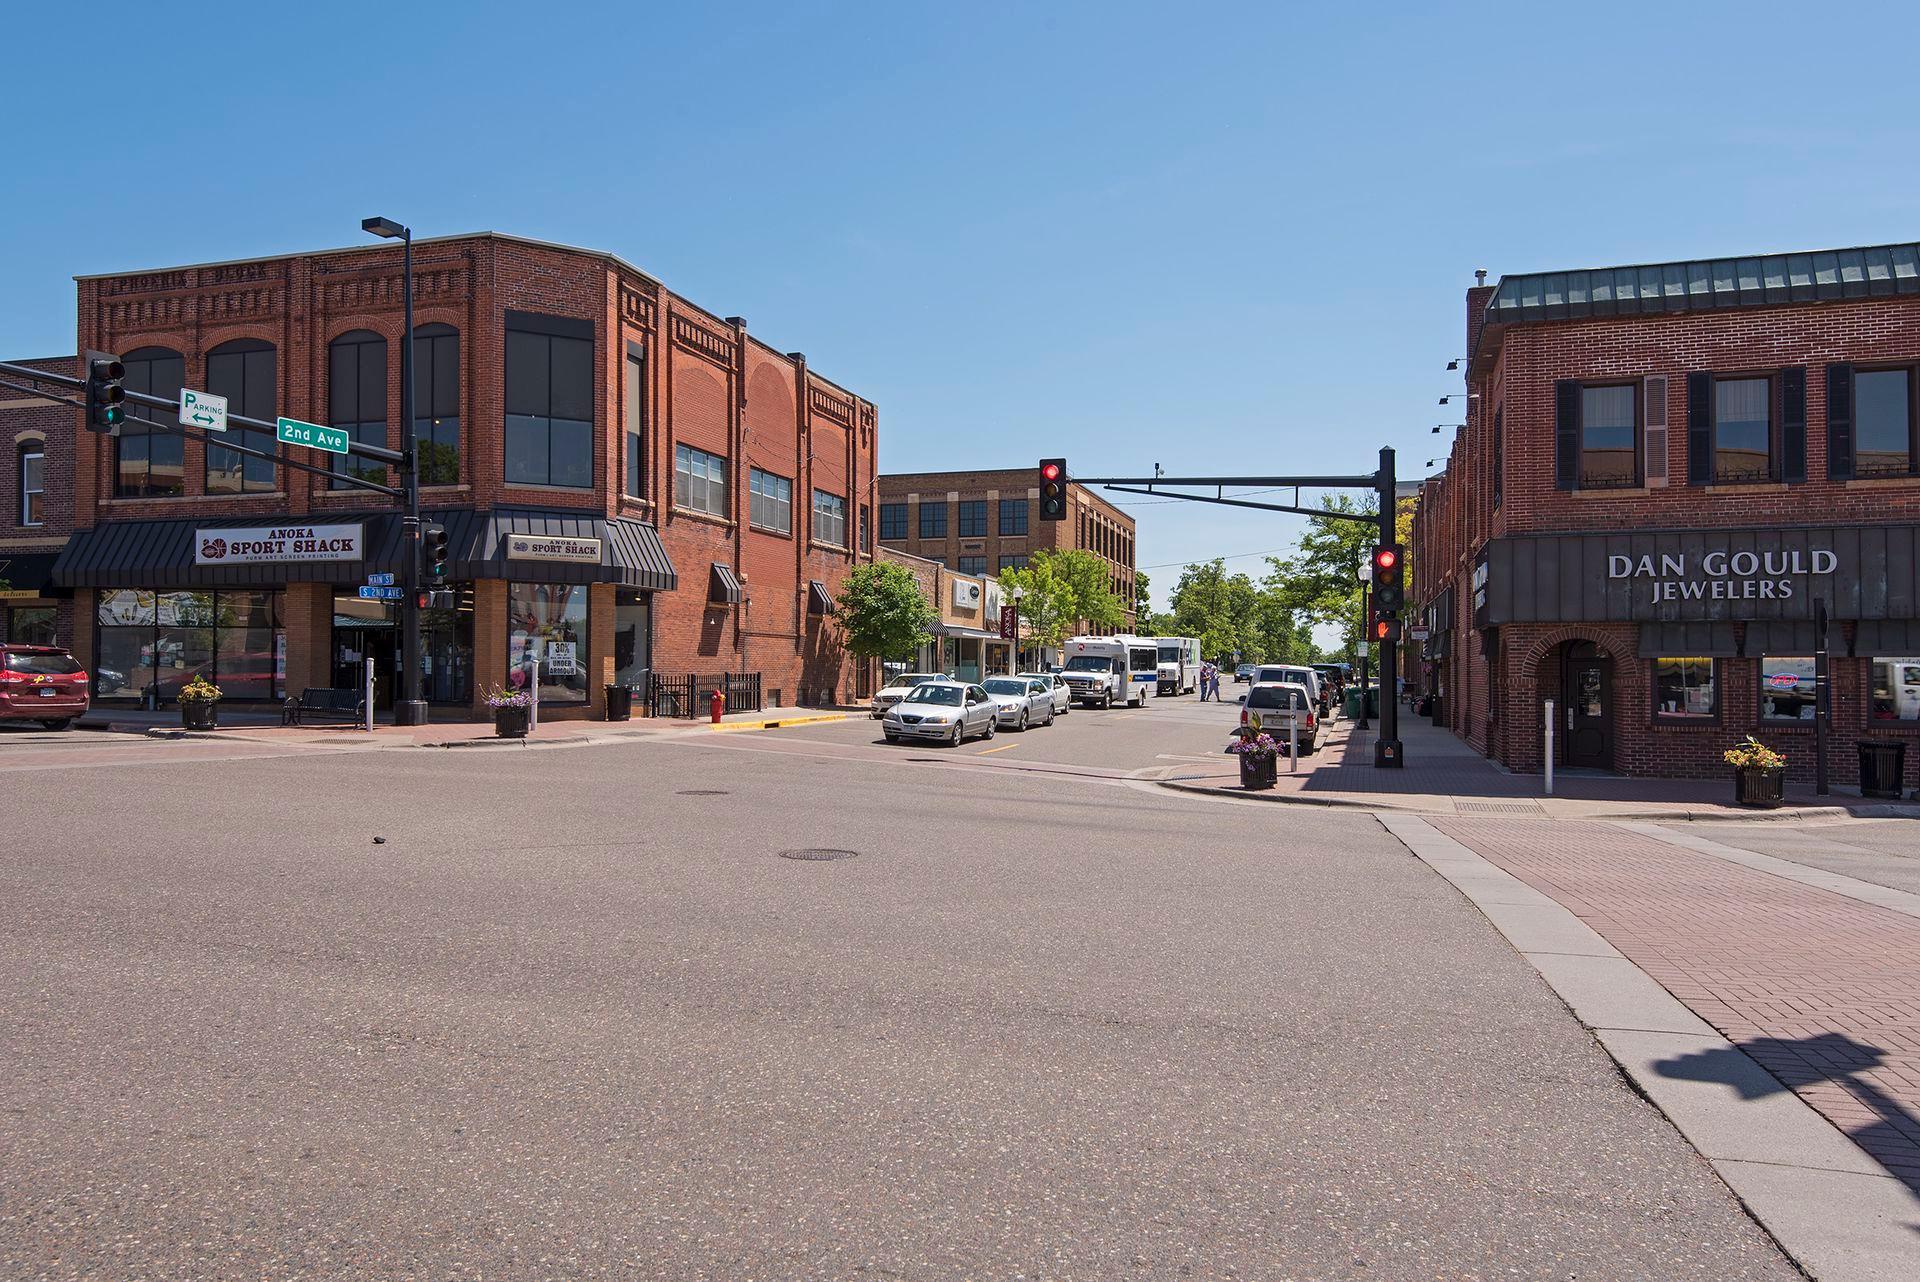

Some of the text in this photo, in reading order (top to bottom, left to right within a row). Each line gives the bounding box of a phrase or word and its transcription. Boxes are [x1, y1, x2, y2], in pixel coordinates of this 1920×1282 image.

[184, 392, 223, 415] PARKING
[284, 425, 342, 447] 2nd Ave
[268, 528, 315, 539] ANOKA
[230, 538, 354, 555] SPORT SHACK
[532, 543, 597, 555] SPORT SHACK
[1608, 550, 1838, 578] DAN GOULD
[370, 575, 383, 584] MAIN
[363, 588, 400, 597] S 2ND AVE
[1651, 579, 1793, 604] JEWELERS
[1004, 608, 1012, 636] ANOKA
[555, 642, 570, 654] 30%
